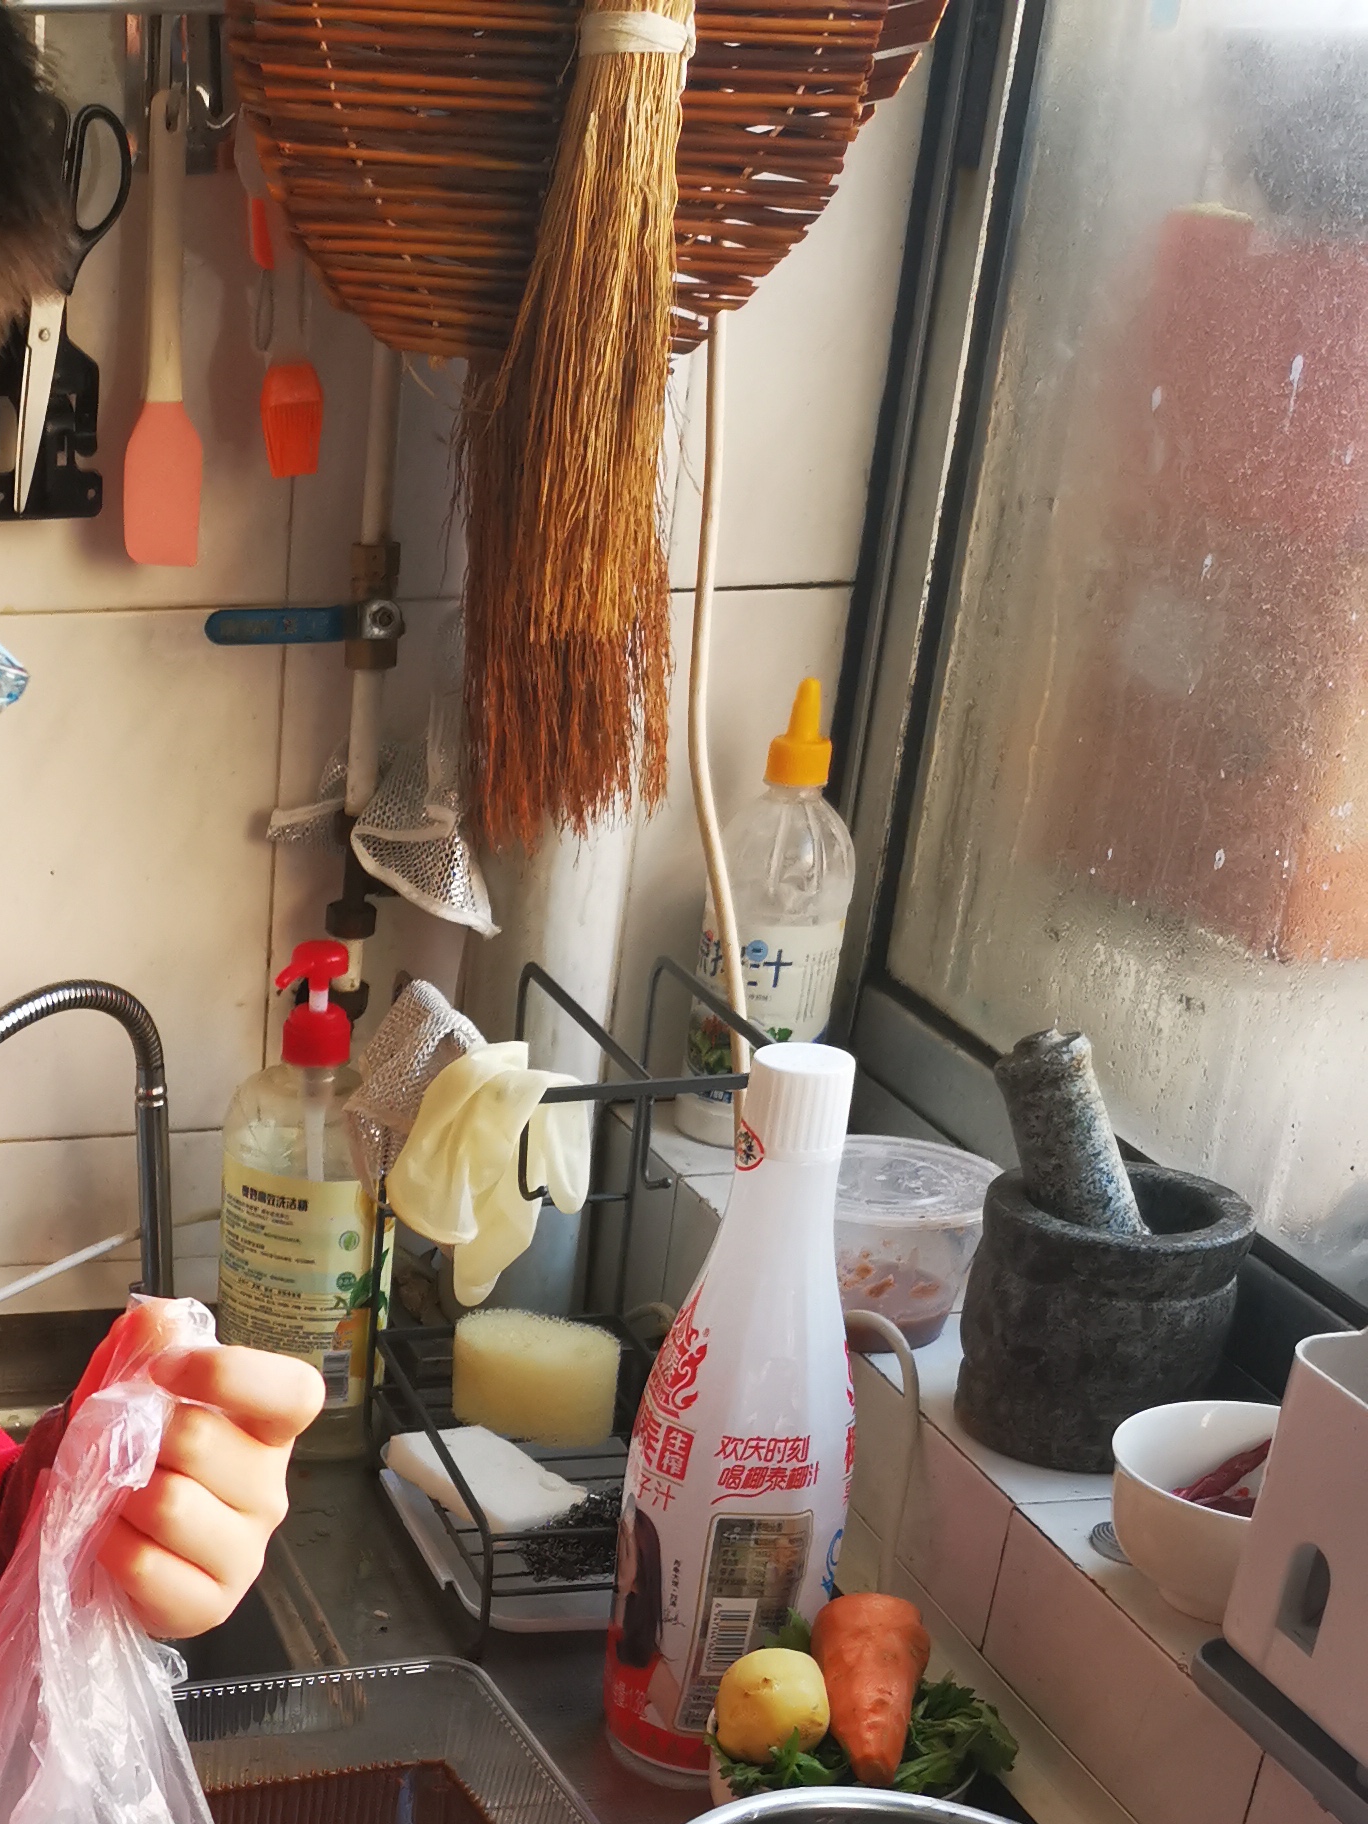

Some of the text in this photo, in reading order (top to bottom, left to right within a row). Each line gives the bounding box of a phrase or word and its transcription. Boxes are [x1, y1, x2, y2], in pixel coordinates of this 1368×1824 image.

[713, 1434, 811, 1464] 欢庆时刻
[717, 1461, 820, 1491] 喝椰泰椰汁
